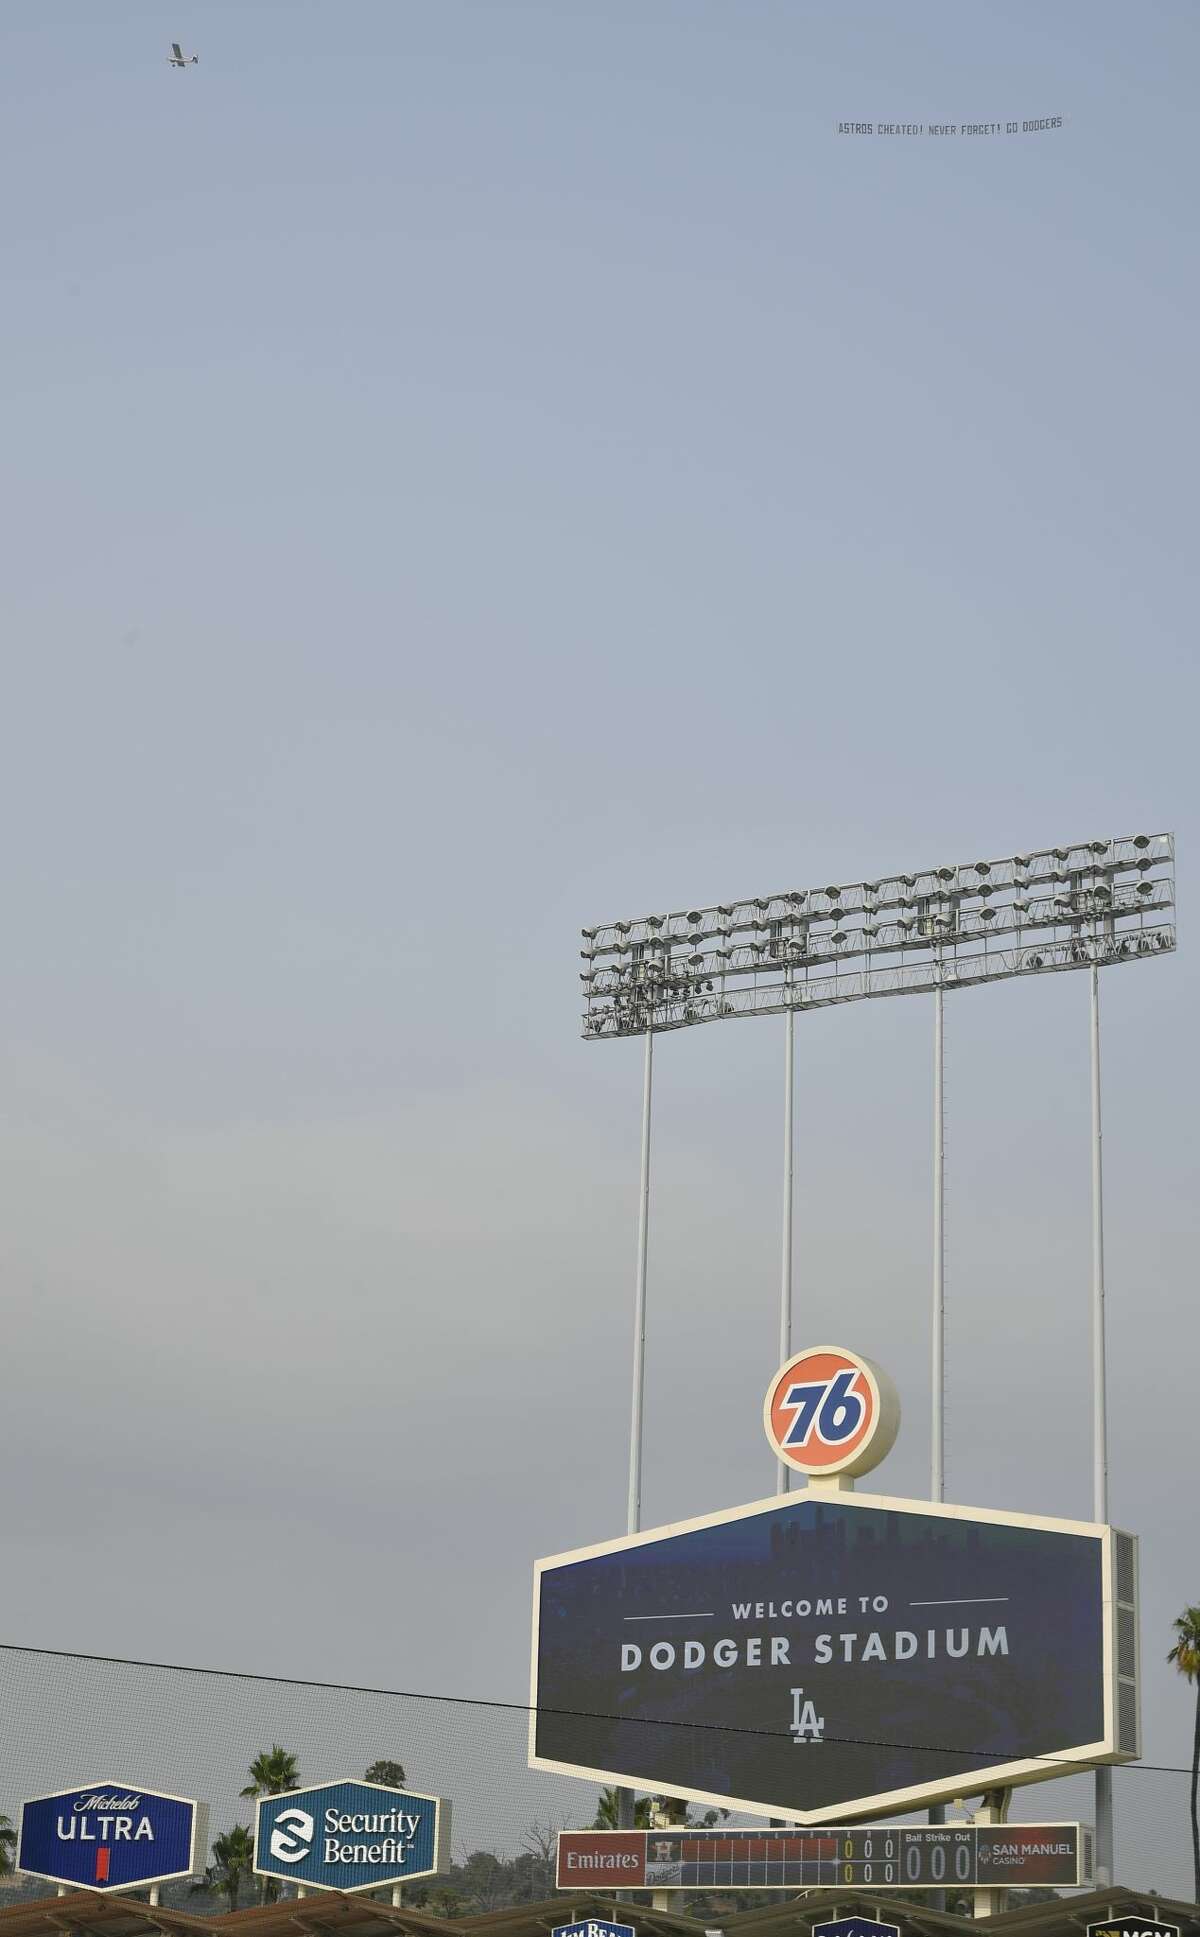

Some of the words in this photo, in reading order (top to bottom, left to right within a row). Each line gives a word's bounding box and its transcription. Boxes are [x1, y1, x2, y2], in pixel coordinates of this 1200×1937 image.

[839, 122, 873, 135] ASTROS
[877, 124, 923, 135] CHEATED!
[928, 125, 957, 136] NEVER
[961, 123, 1001, 135] FORGET!
[1006, 122, 1018, 134] GO
[1022, 117, 1063, 132] DODGERS
[779, 1368, 866, 1448] 76
[732, 1598, 847, 1620] WELCOME
[859, 1595, 889, 1614] TO
[621, 1637, 791, 1671] DODGER
[813, 1626, 1009, 1664] STADIUM
[790, 1688, 825, 1743] LA
[73, 1794, 142, 1811] Michelob
[57, 1816, 155, 1840] ULTRA
[324, 1808, 421, 1839] Security
[905, 1833, 922, 1842] Ball
[925, 1833, 951, 1842] Strike
[955, 1833, 971, 1842] Out
[323, 1838, 406, 1863] Benefit
[567, 1850, 639, 1868] Emirates
[844, 1839, 853, 1858] 0
[864, 1839, 872, 1858] 0
[885, 1839, 893, 1858] 0
[992, 1844, 1019, 1856] SAN
[1021, 1843, 1074, 1855] MANUEL
[906, 1845, 921, 1881] 0
[931, 1845, 946, 1880] 0
[955, 1845, 970, 1880] 0
[992, 1857, 1025, 1865] CASINO
[844, 1863, 853, 1882] 0
[864, 1863, 872, 1882] 0
[885, 1863, 893, 1882] 0
